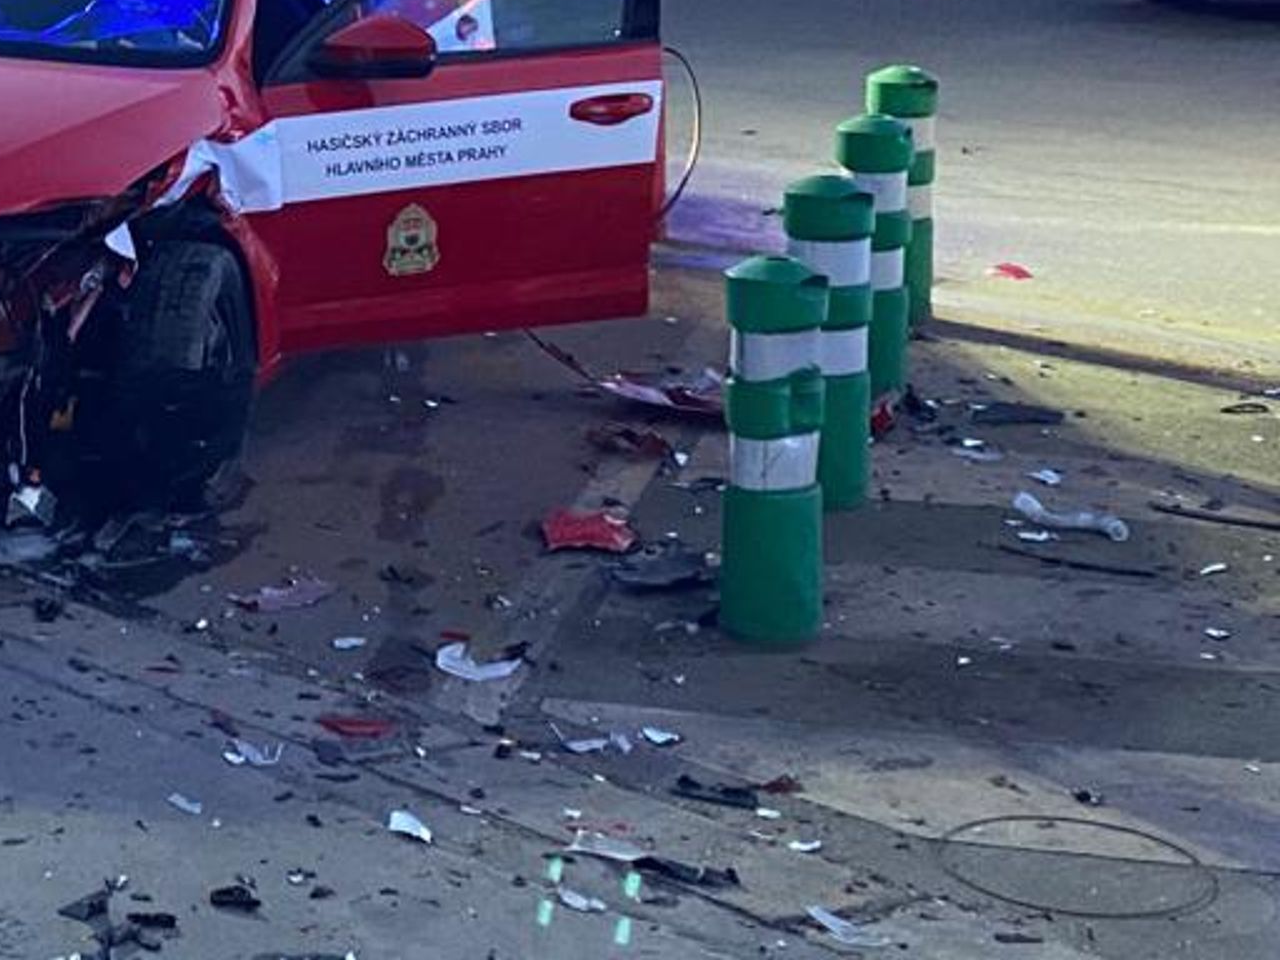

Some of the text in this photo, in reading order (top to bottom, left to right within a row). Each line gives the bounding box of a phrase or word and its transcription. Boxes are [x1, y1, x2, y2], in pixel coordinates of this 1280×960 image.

[307, 117, 521, 153] HASIČSKÝ ZÁCHRANNÝ SBOR
[326, 157, 401, 178] HLAVNÍHO
[457, 144, 508, 162] PRAHY
